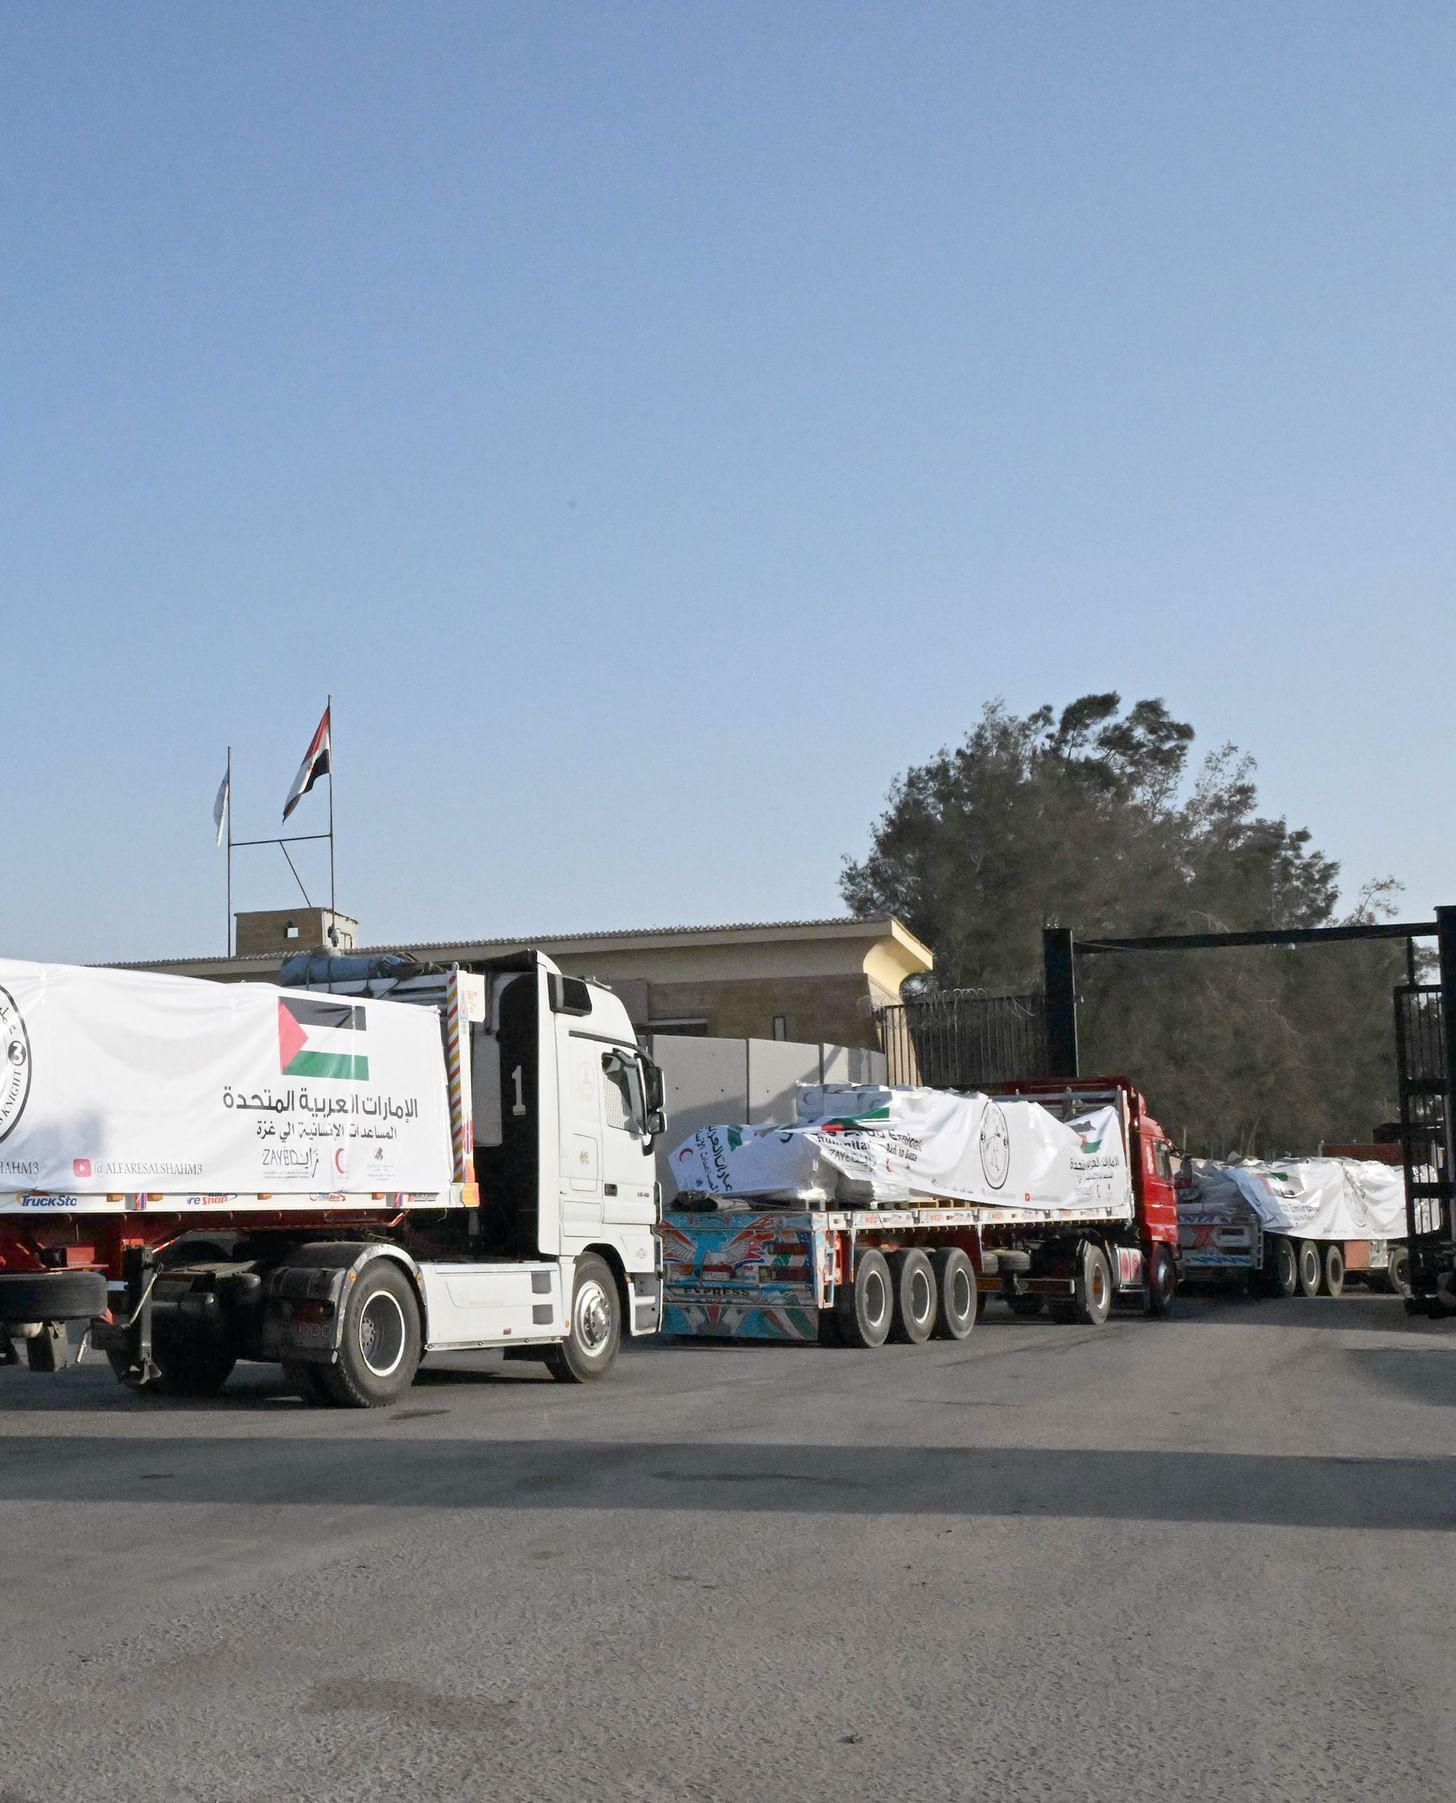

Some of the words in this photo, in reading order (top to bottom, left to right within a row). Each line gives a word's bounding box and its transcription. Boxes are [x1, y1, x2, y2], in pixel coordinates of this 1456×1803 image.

[2, 1069, 22, 1118] KNIGHT
[223, 1086, 295, 1113] المتحدة
[299, 1088, 359, 1118] العربية
[511, 1064, 526, 1116] 1
[257, 1120, 276, 1139] غزة
[349, 1122, 397, 1140] المساعدات
